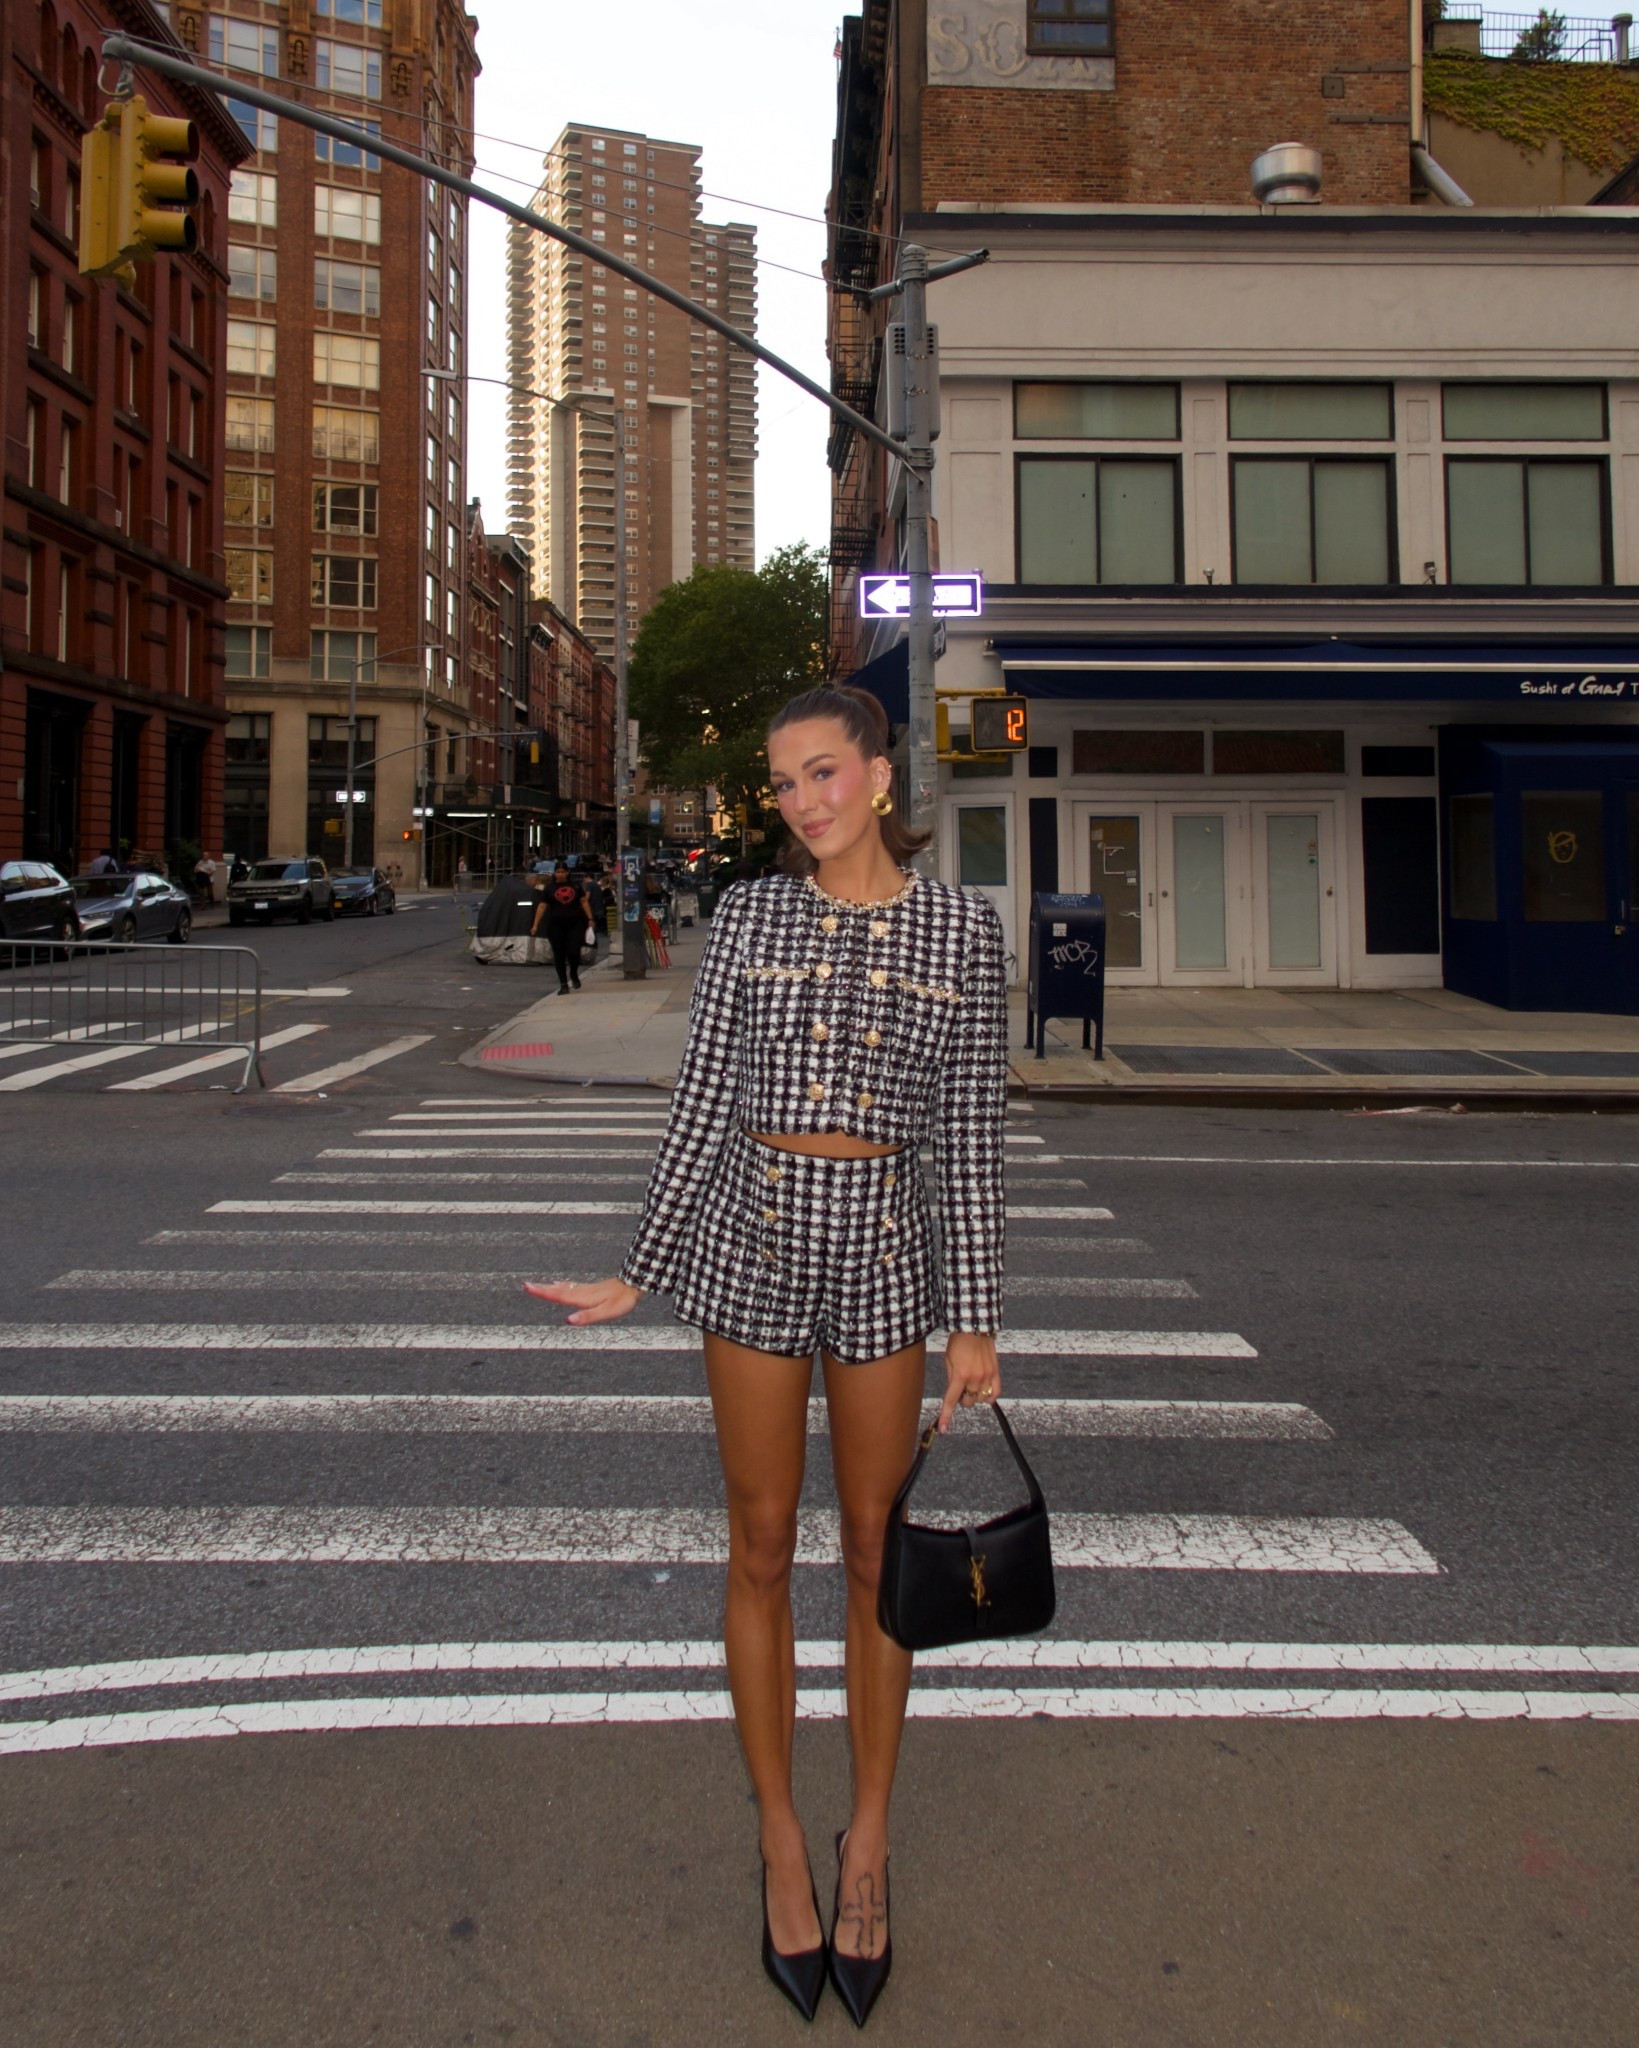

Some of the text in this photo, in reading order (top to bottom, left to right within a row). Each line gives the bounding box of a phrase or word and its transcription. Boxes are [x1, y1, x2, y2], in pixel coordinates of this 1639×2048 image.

[1520, 681, 1558, 694] Sushi
[1561, 682, 1576, 694] of
[1007, 708, 1024, 741] 12
